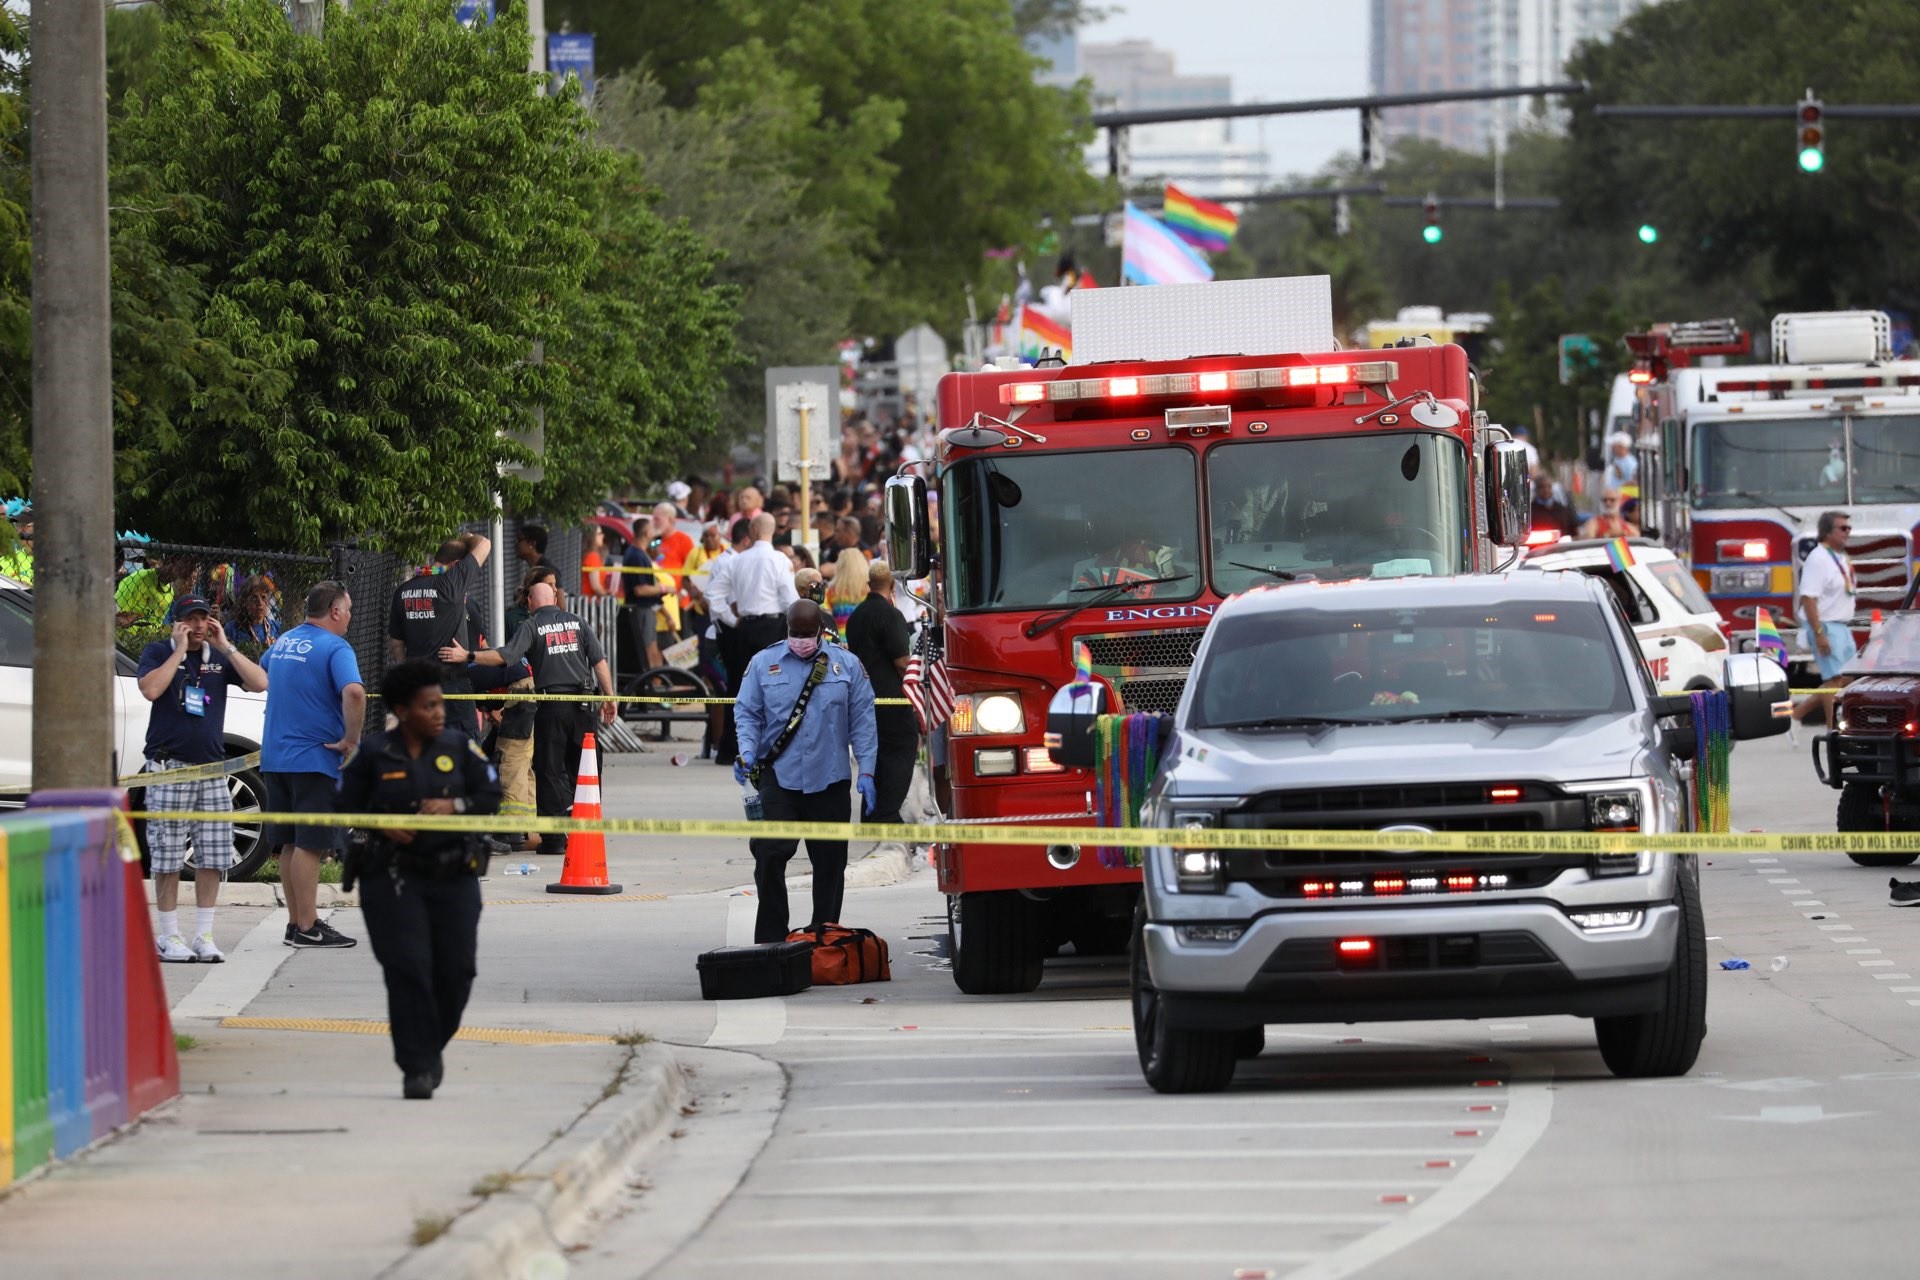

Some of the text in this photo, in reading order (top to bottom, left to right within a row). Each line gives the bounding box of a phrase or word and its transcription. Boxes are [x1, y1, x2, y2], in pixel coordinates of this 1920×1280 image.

[401, 588, 438, 599] OAKLAND PARK
[404, 599, 432, 611] FIRE
[406, 610, 435, 620] RESCUE
[1105, 604, 1217, 621] ENGIN
[537, 621, 581, 636] OAKLAND PARK
[546, 630, 577, 646] FIRE
[548, 642, 579, 655] RESCUE
